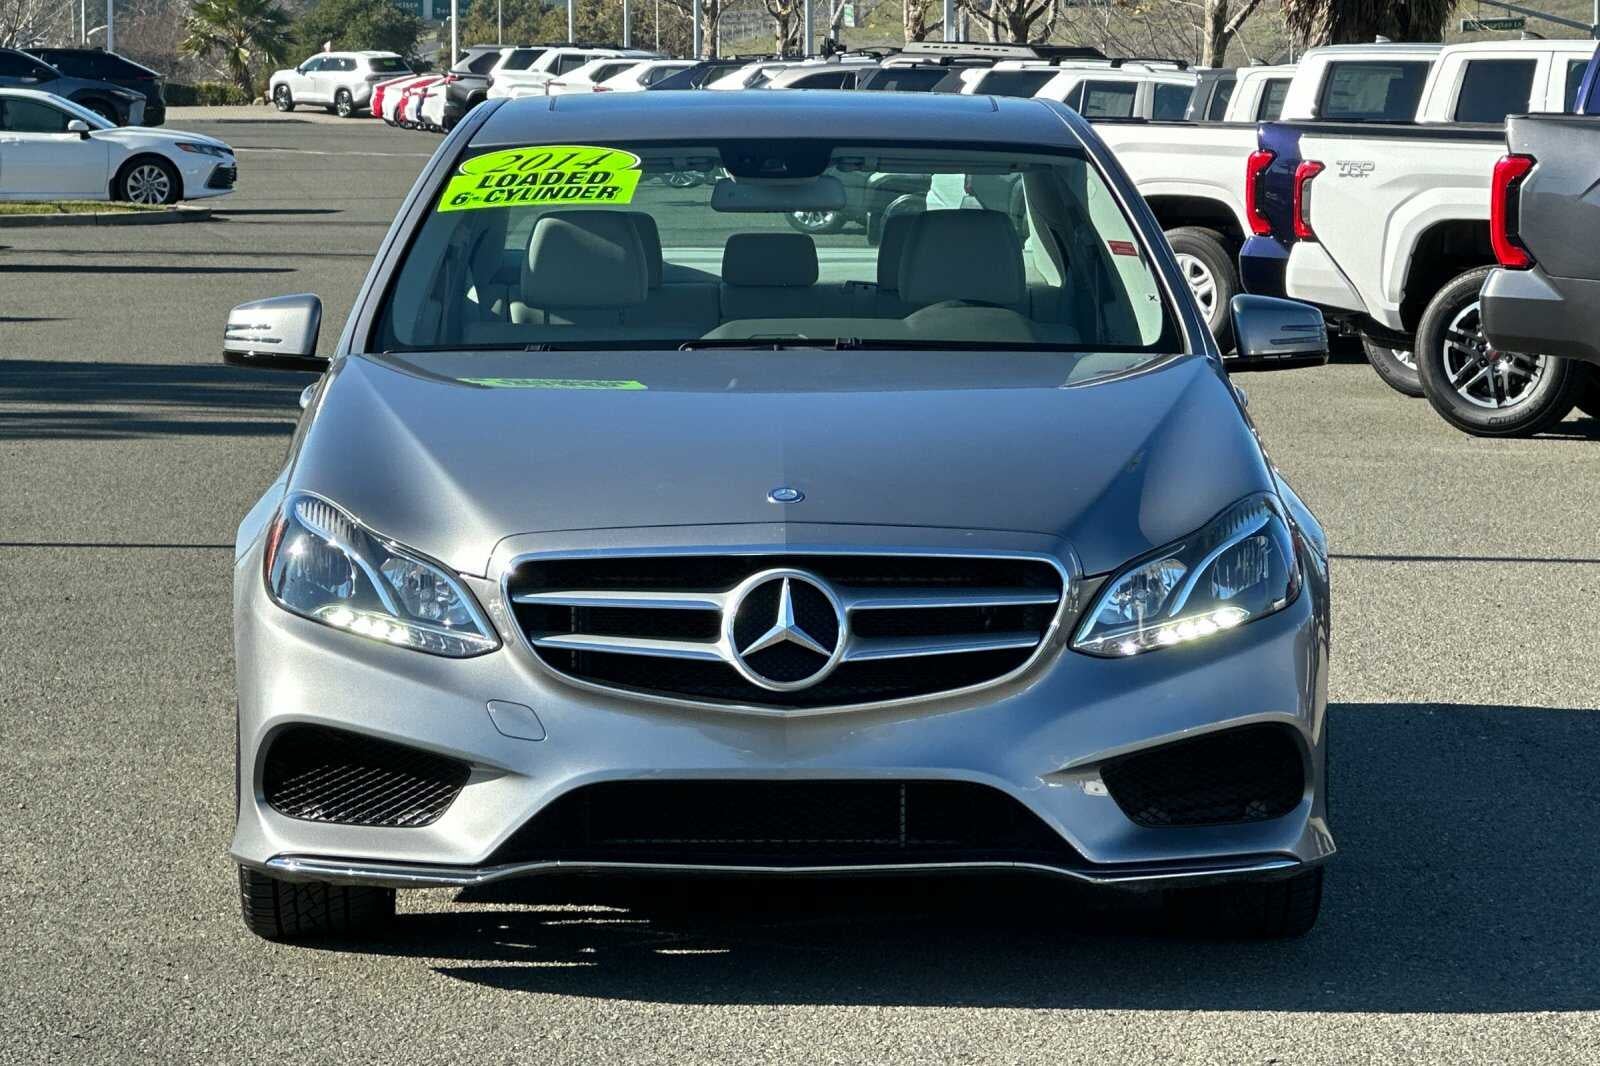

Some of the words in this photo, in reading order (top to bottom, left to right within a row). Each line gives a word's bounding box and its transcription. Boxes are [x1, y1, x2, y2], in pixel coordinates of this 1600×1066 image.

[487, 152, 614, 173] 2014
[1336, 160, 1375, 174] TRD
[476, 171, 613, 189] LOADED
[450, 186, 621, 205] 6-CYLINDER
